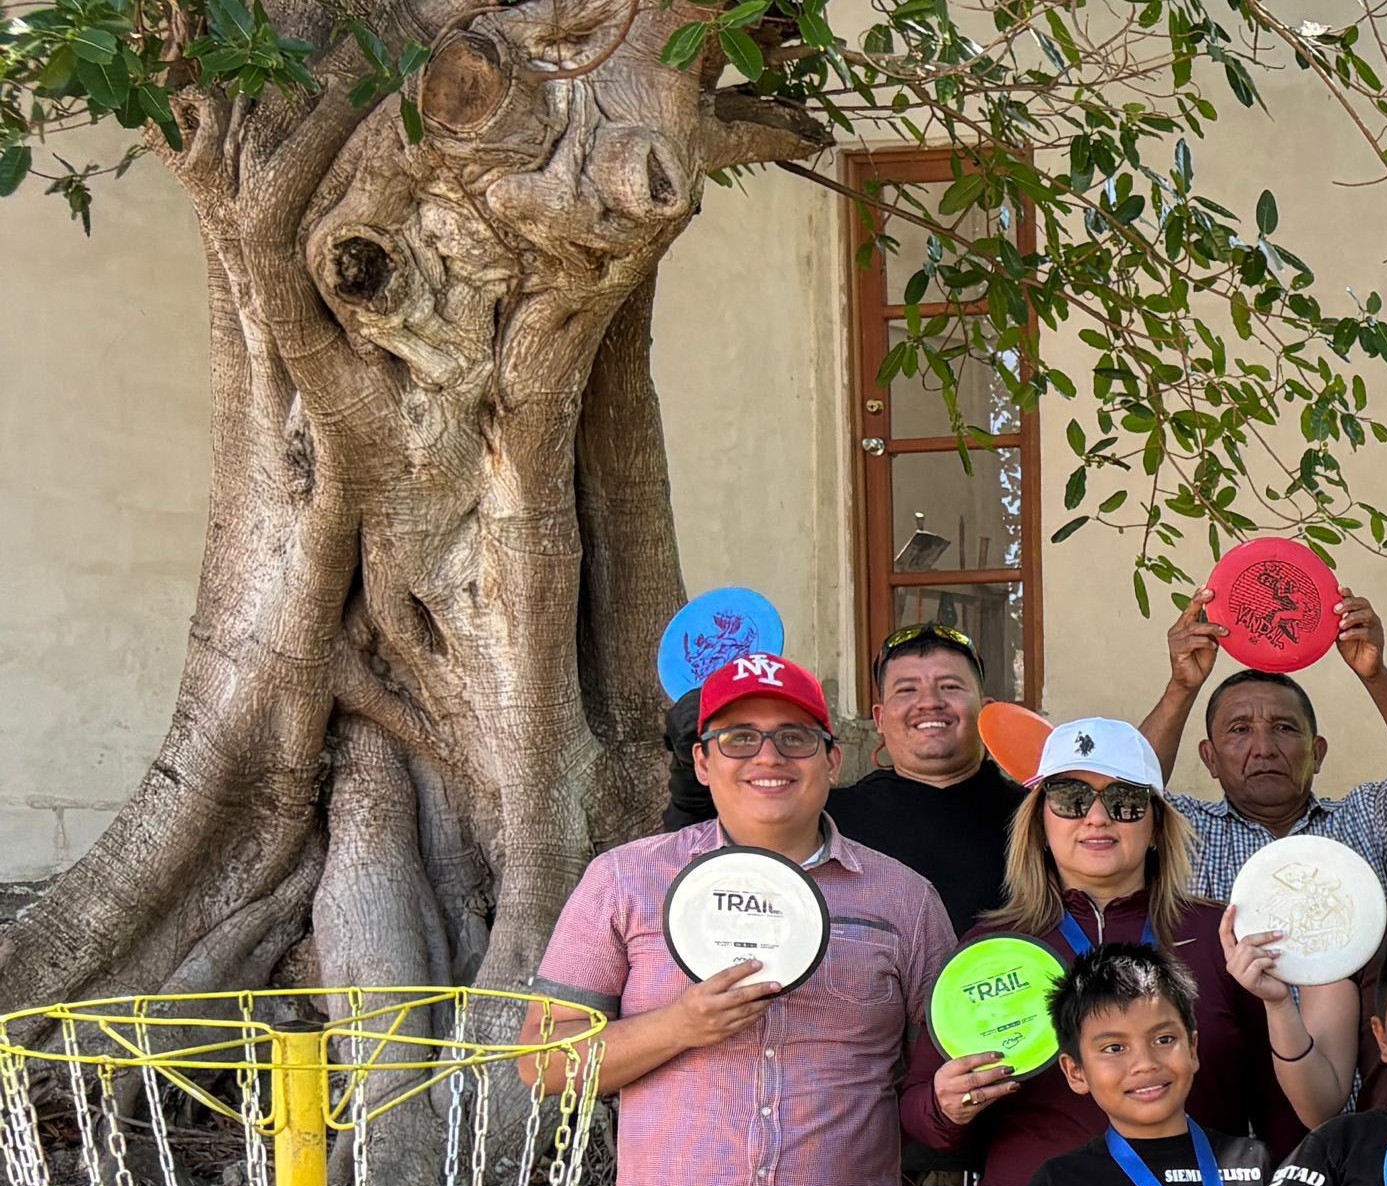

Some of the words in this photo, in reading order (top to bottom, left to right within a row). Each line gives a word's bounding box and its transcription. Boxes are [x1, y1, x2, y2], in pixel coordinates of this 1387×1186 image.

[732, 654, 785, 687] NY
[713, 892, 782, 915] TRAIL
[963, 971, 1030, 1004] TRAIL
[1223, 1167, 1261, 1181] LISTO
